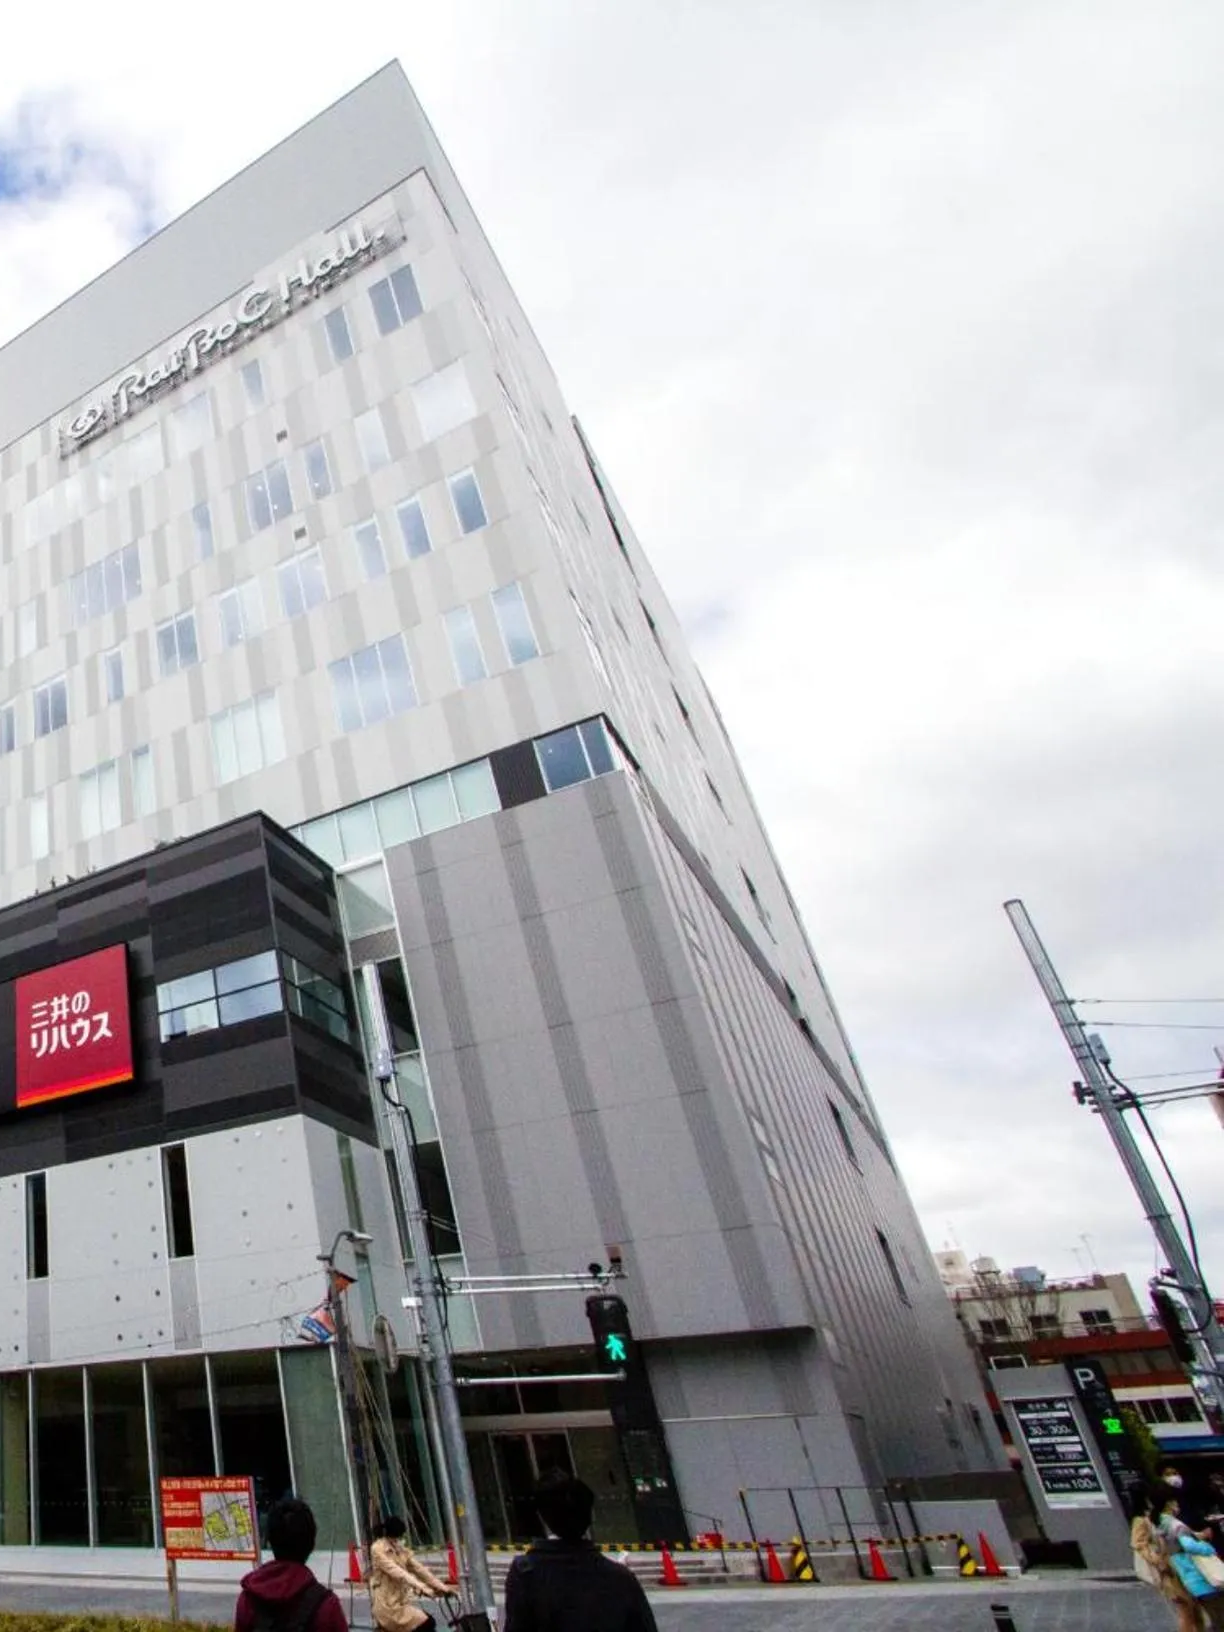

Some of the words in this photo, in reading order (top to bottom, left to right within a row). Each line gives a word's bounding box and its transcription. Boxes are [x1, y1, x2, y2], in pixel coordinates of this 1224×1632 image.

[31, 991, 91, 1029] 三井の
[30, 1011, 113, 1059] リハウス
[1074, 1368, 1096, 1390] P
